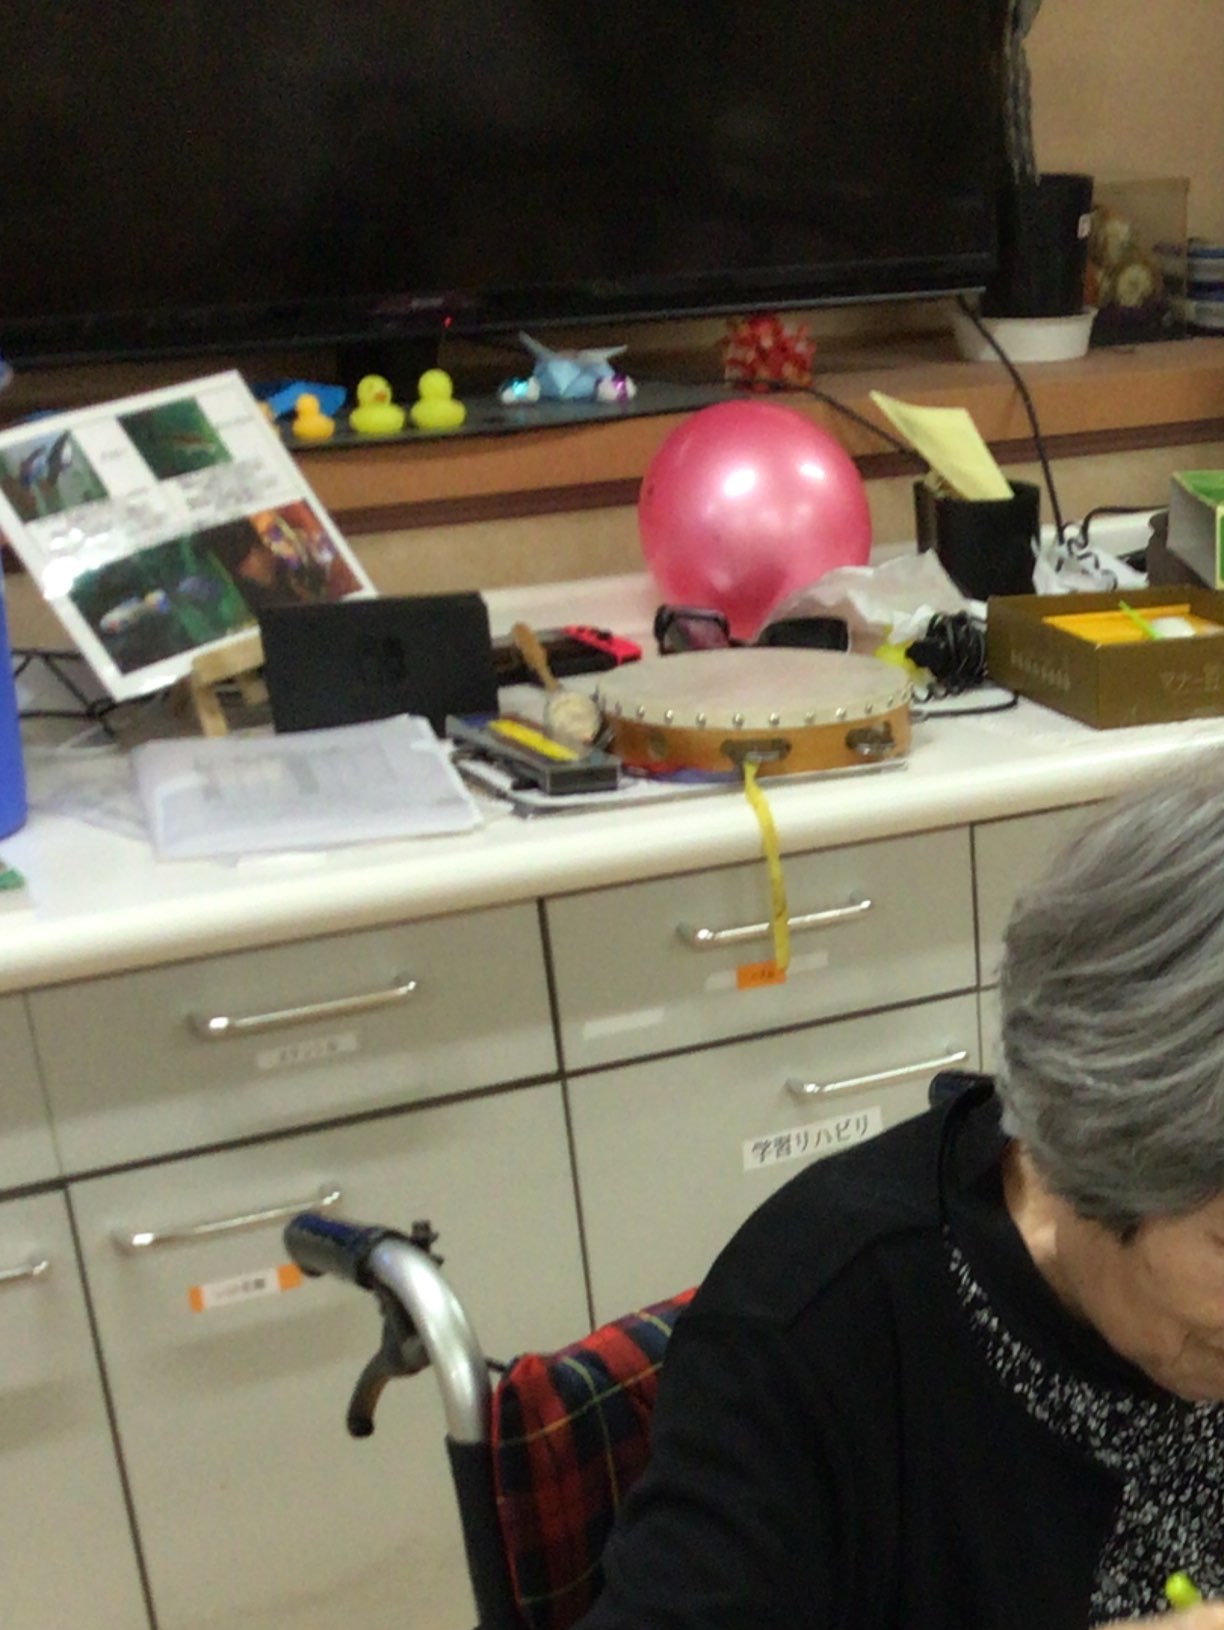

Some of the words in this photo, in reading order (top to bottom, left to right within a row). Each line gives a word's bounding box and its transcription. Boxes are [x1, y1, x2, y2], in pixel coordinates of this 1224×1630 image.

[752, 1115, 870, 1163] 学習リハビリ
